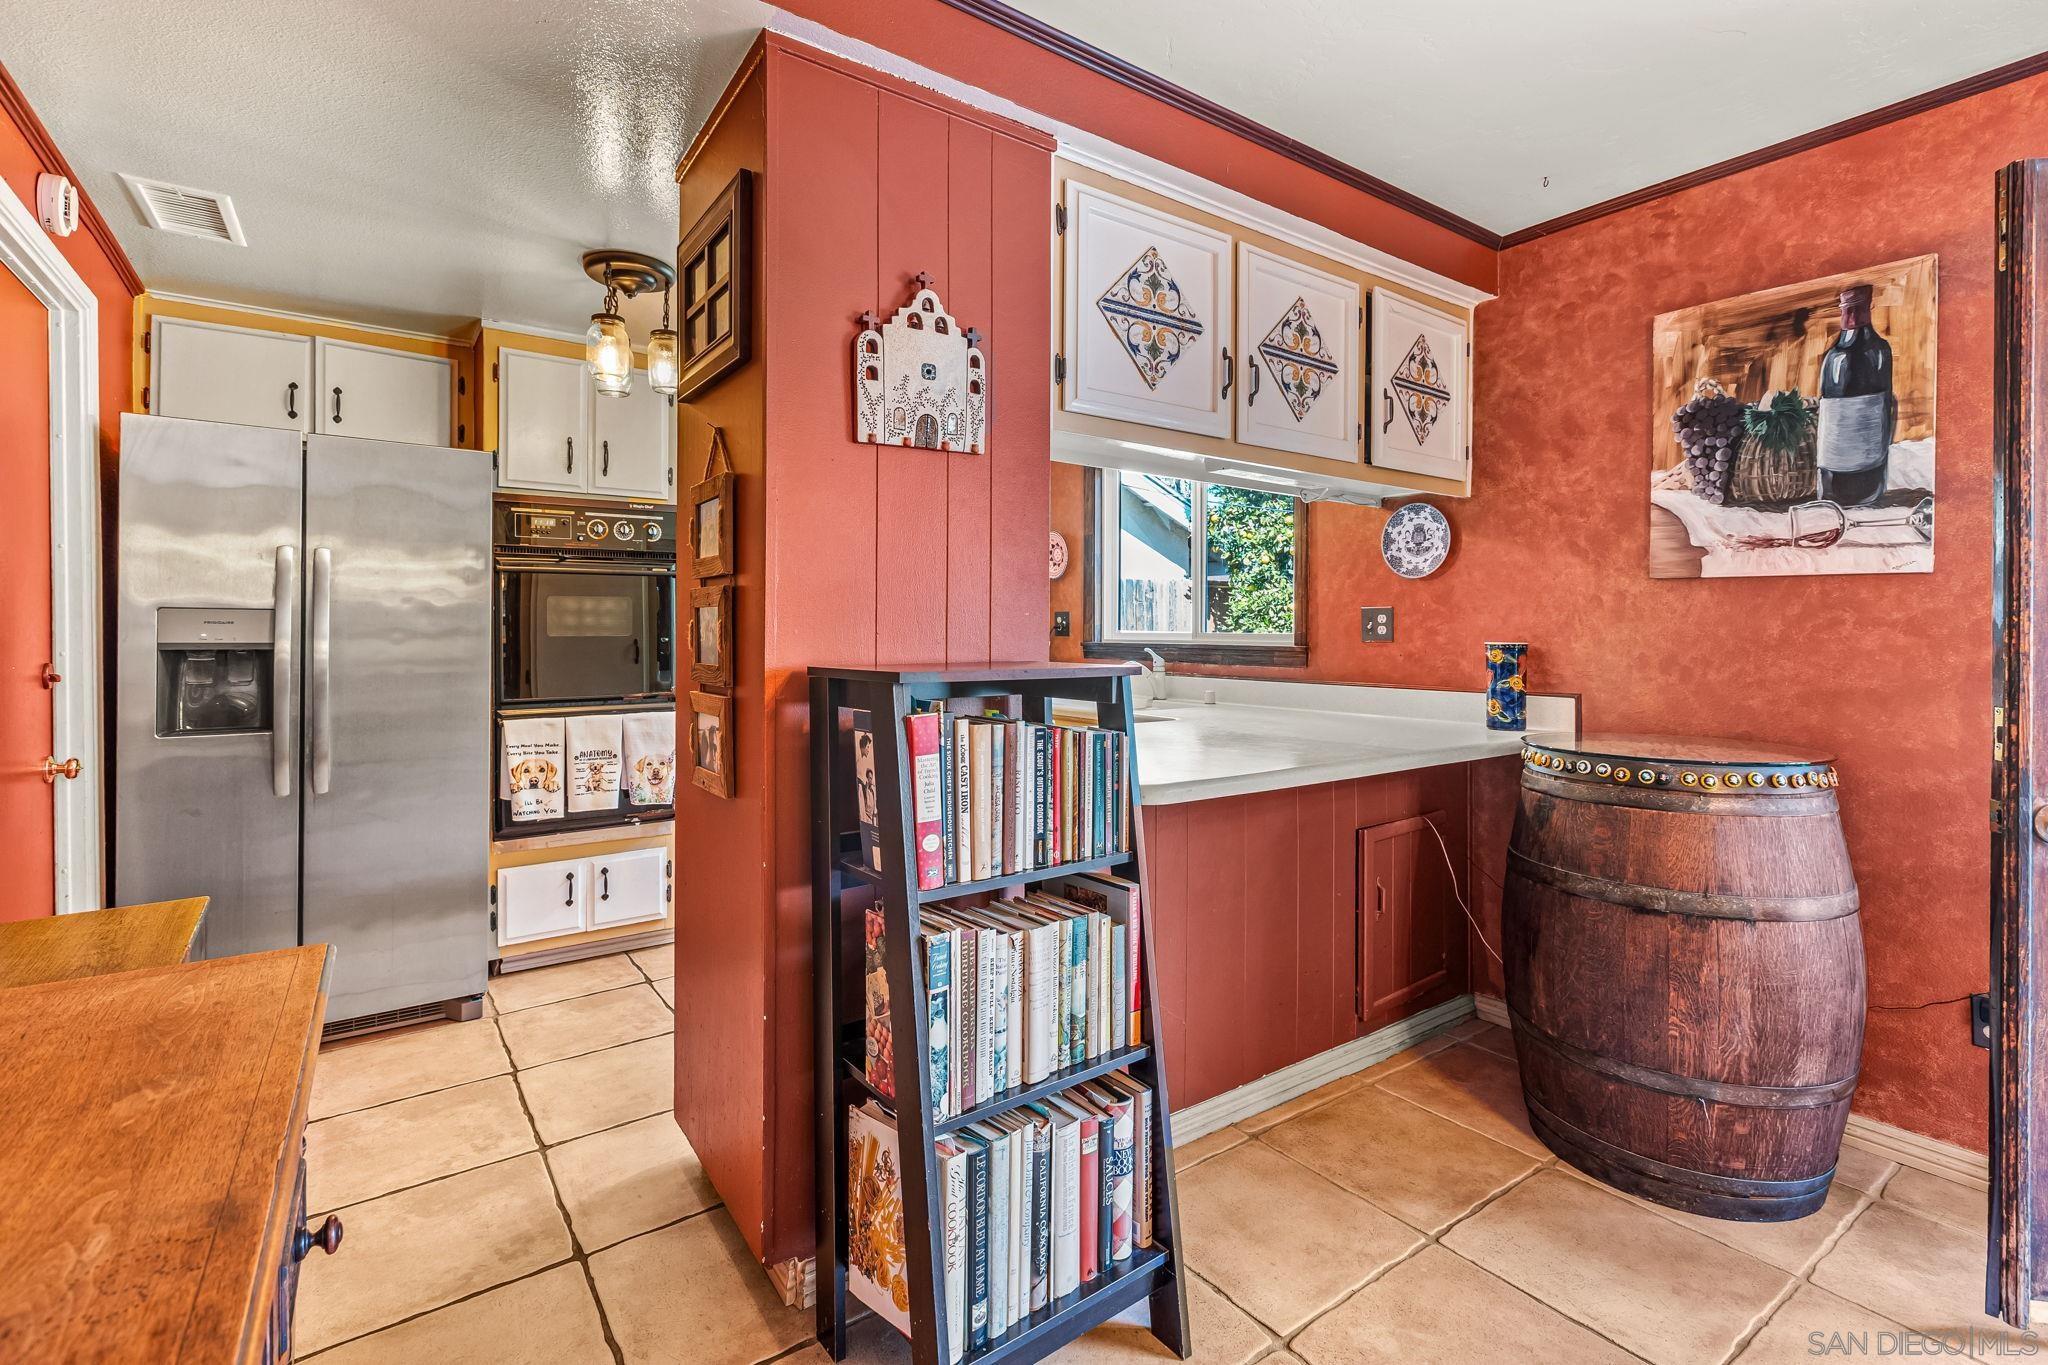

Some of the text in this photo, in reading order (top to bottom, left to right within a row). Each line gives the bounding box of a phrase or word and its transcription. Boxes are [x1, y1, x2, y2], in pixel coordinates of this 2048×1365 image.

[579, 749, 613, 758] ANATOMY
[1036, 740, 1044, 750] THE
[960, 765, 969, 788] CAST
[1036, 752, 1044, 776] SCOUT'S
[961, 790, 969, 815] IRON
[1015, 770, 1023, 816] RISOTTO
[1036, 777, 1044, 803] OUTDOOR
[544, 807, 558, 815] YOU
[961, 939, 969, 1089] HERITAGE COOKBOOK
[1024, 1140, 1033, 1160] Julia
[1025, 1161, 1033, 1186] Child
[1105, 1156, 1114, 1206] SAUCES
[975, 1154, 986, 1298] LE CORDON BLEU AT HOME
[1022, 1200, 1033, 1249] Company
[1039, 1158, 1047, 1276] CALIFORNIA COOKBOOK
[947, 1202, 958, 1275] COOKBOOK
